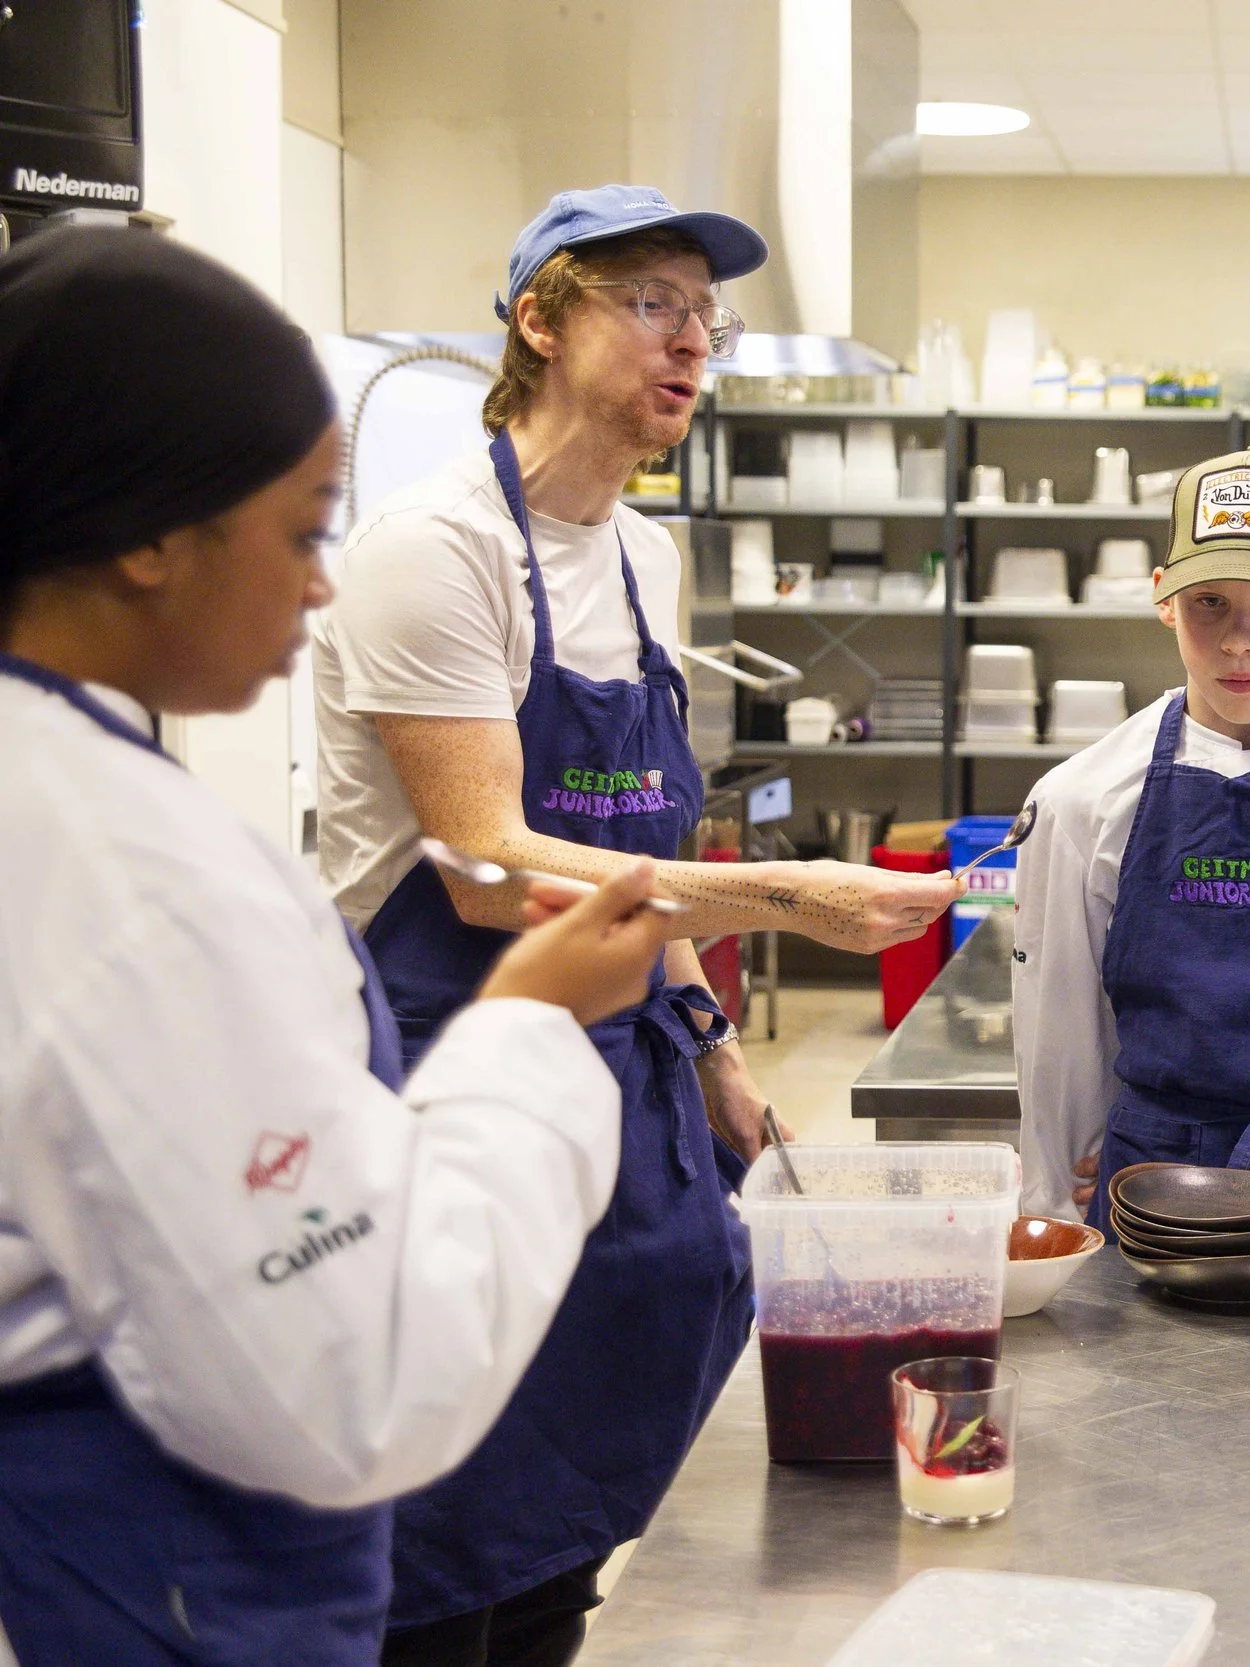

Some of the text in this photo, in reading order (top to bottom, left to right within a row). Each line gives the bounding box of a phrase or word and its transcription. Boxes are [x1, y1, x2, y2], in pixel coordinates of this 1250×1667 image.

[15, 168, 140, 202] Nederman
[1202, 493, 1209, 501] 2
[1211, 487, 1232, 502] Von
